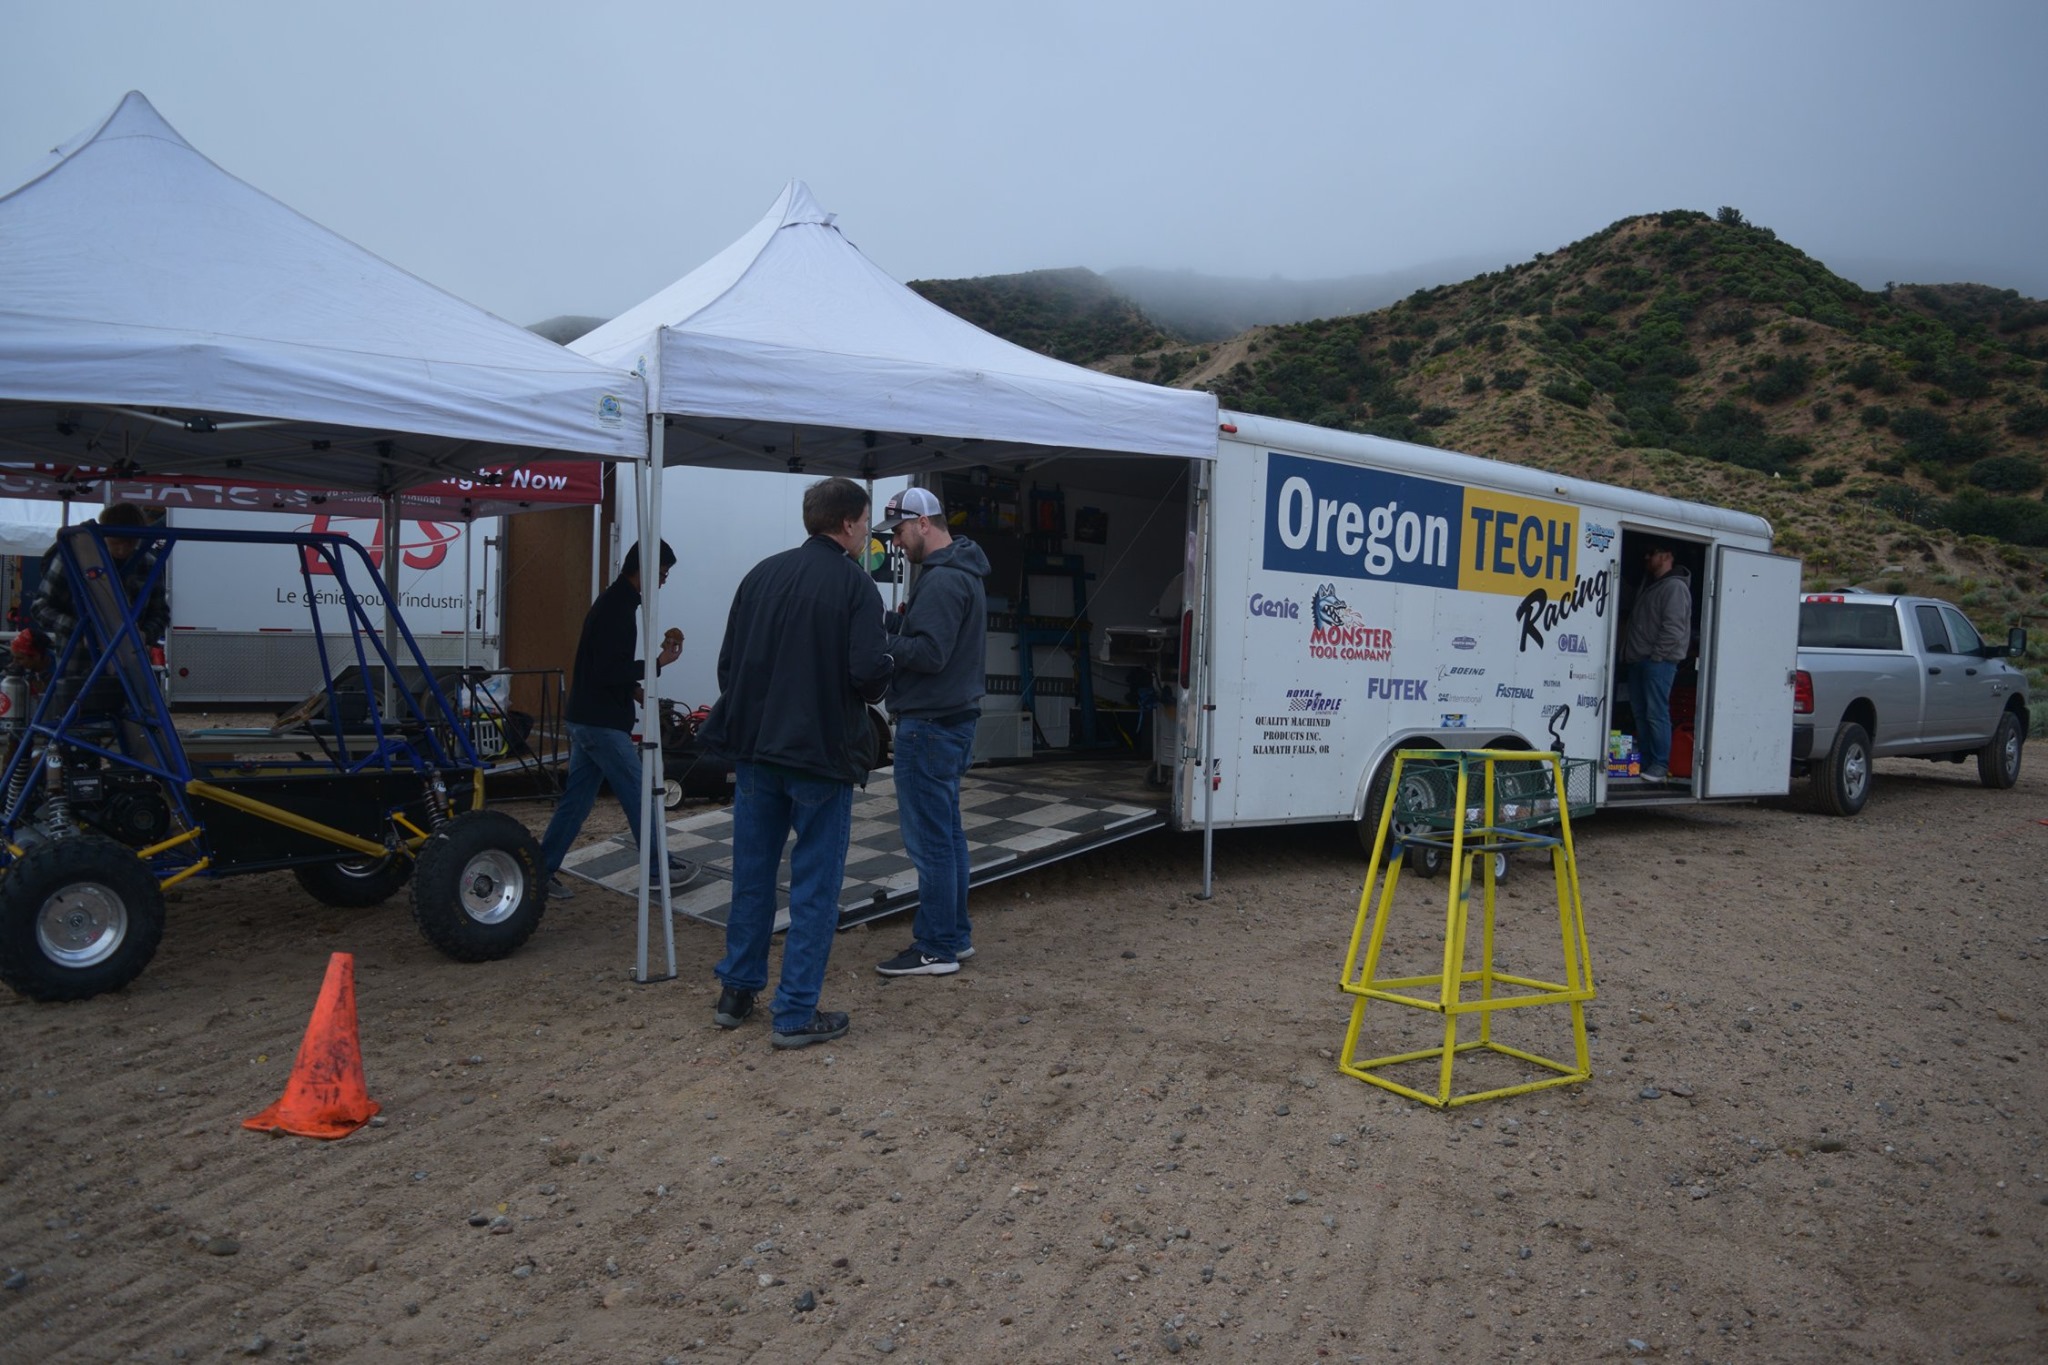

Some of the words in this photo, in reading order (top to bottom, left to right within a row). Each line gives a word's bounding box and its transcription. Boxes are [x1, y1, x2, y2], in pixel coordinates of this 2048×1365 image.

[511, 469, 568, 490] Now
[1278, 476, 1448, 576] Oregon
[1471, 507, 1571, 581] TECH
[277, 588, 297, 603] Le
[302, 588, 347, 608] génie
[354, 592, 386, 608] pou
[1249, 593, 1299, 619] Genie
[1516, 568, 1609, 652] Racing
[1310, 626, 1393, 649] MONSTER
[1309, 645, 1338, 659] TOOL
[1340, 647, 1391, 662] COMPANY
[1449, 667, 1485, 676] BOEING
[1286, 689, 1314, 698] ROYAL
[1367, 678, 1428, 701] FUTEK
[1305, 698, 1342, 711] PURPLE
[1577, 694, 1598, 708] Airgas
[1255, 716, 1289, 726] QUALITY
[1291, 716, 1331, 727] MACHINED
[1263, 731, 1304, 741] PRODUCTS
[1306, 732, 1321, 741] INC.
[1253, 745, 1290, 755] KLAMATH
[1292, 745, 1317, 755] FALLS,
[1319, 745, 1330, 754] OR
